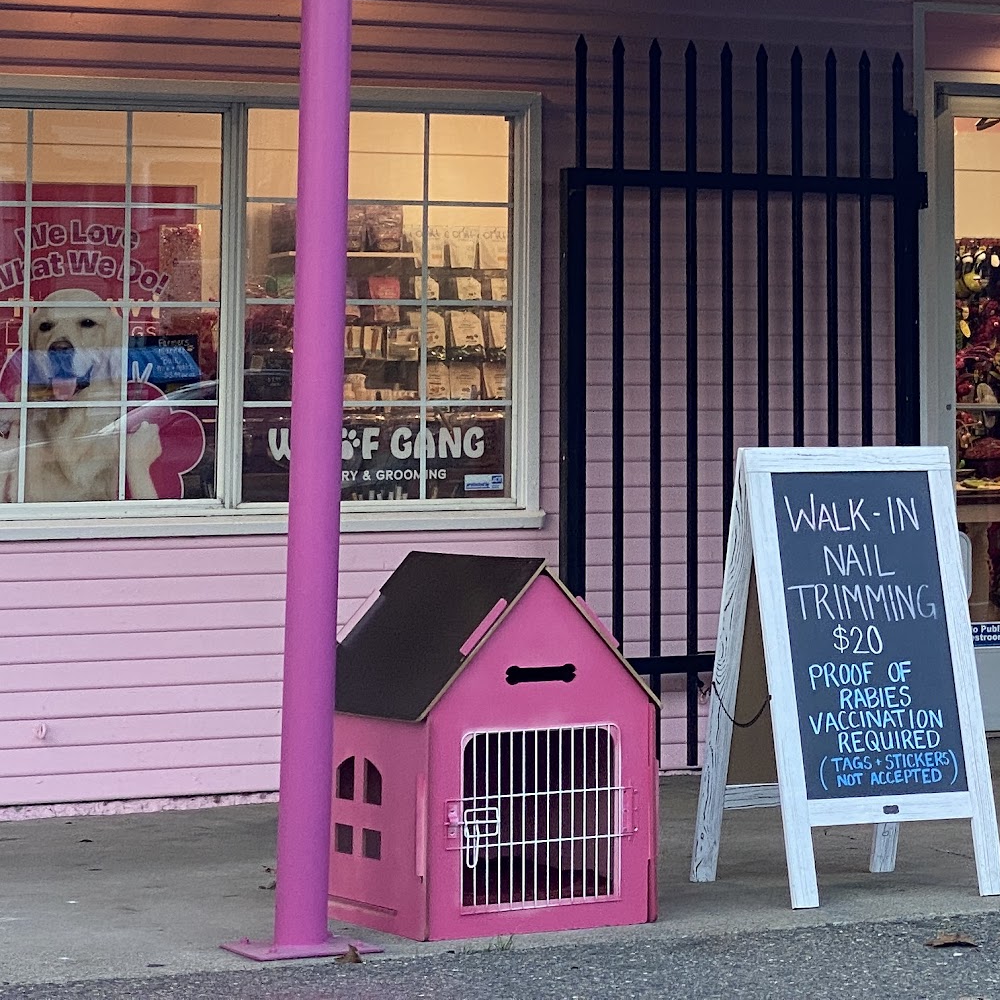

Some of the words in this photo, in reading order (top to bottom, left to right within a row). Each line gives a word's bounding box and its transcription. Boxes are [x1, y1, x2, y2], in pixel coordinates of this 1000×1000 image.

[14, 222, 67, 250] We
[70, 219, 141, 250] Love
[67, 250, 117, 278] We
[117, 257, 170, 295] Do!
[268, 427, 380, 461] WF
[390, 426, 485, 460] GANG
[362, 471, 372, 481] &
[783, 493, 920, 534] WALK-IN
[823, 544, 896, 577] NAIL
[787, 583, 938, 621] TRIMMING
[833, 624, 884, 655] $20
[808, 661, 874, 690] PROOF
[887, 660, 912, 683] OF
[839, 686, 912, 710] RABIES
[808, 709, 944, 735] VACCINATION
[837, 730, 941, 753] REQUIRED
[836, 772, 864, 787] NOT
